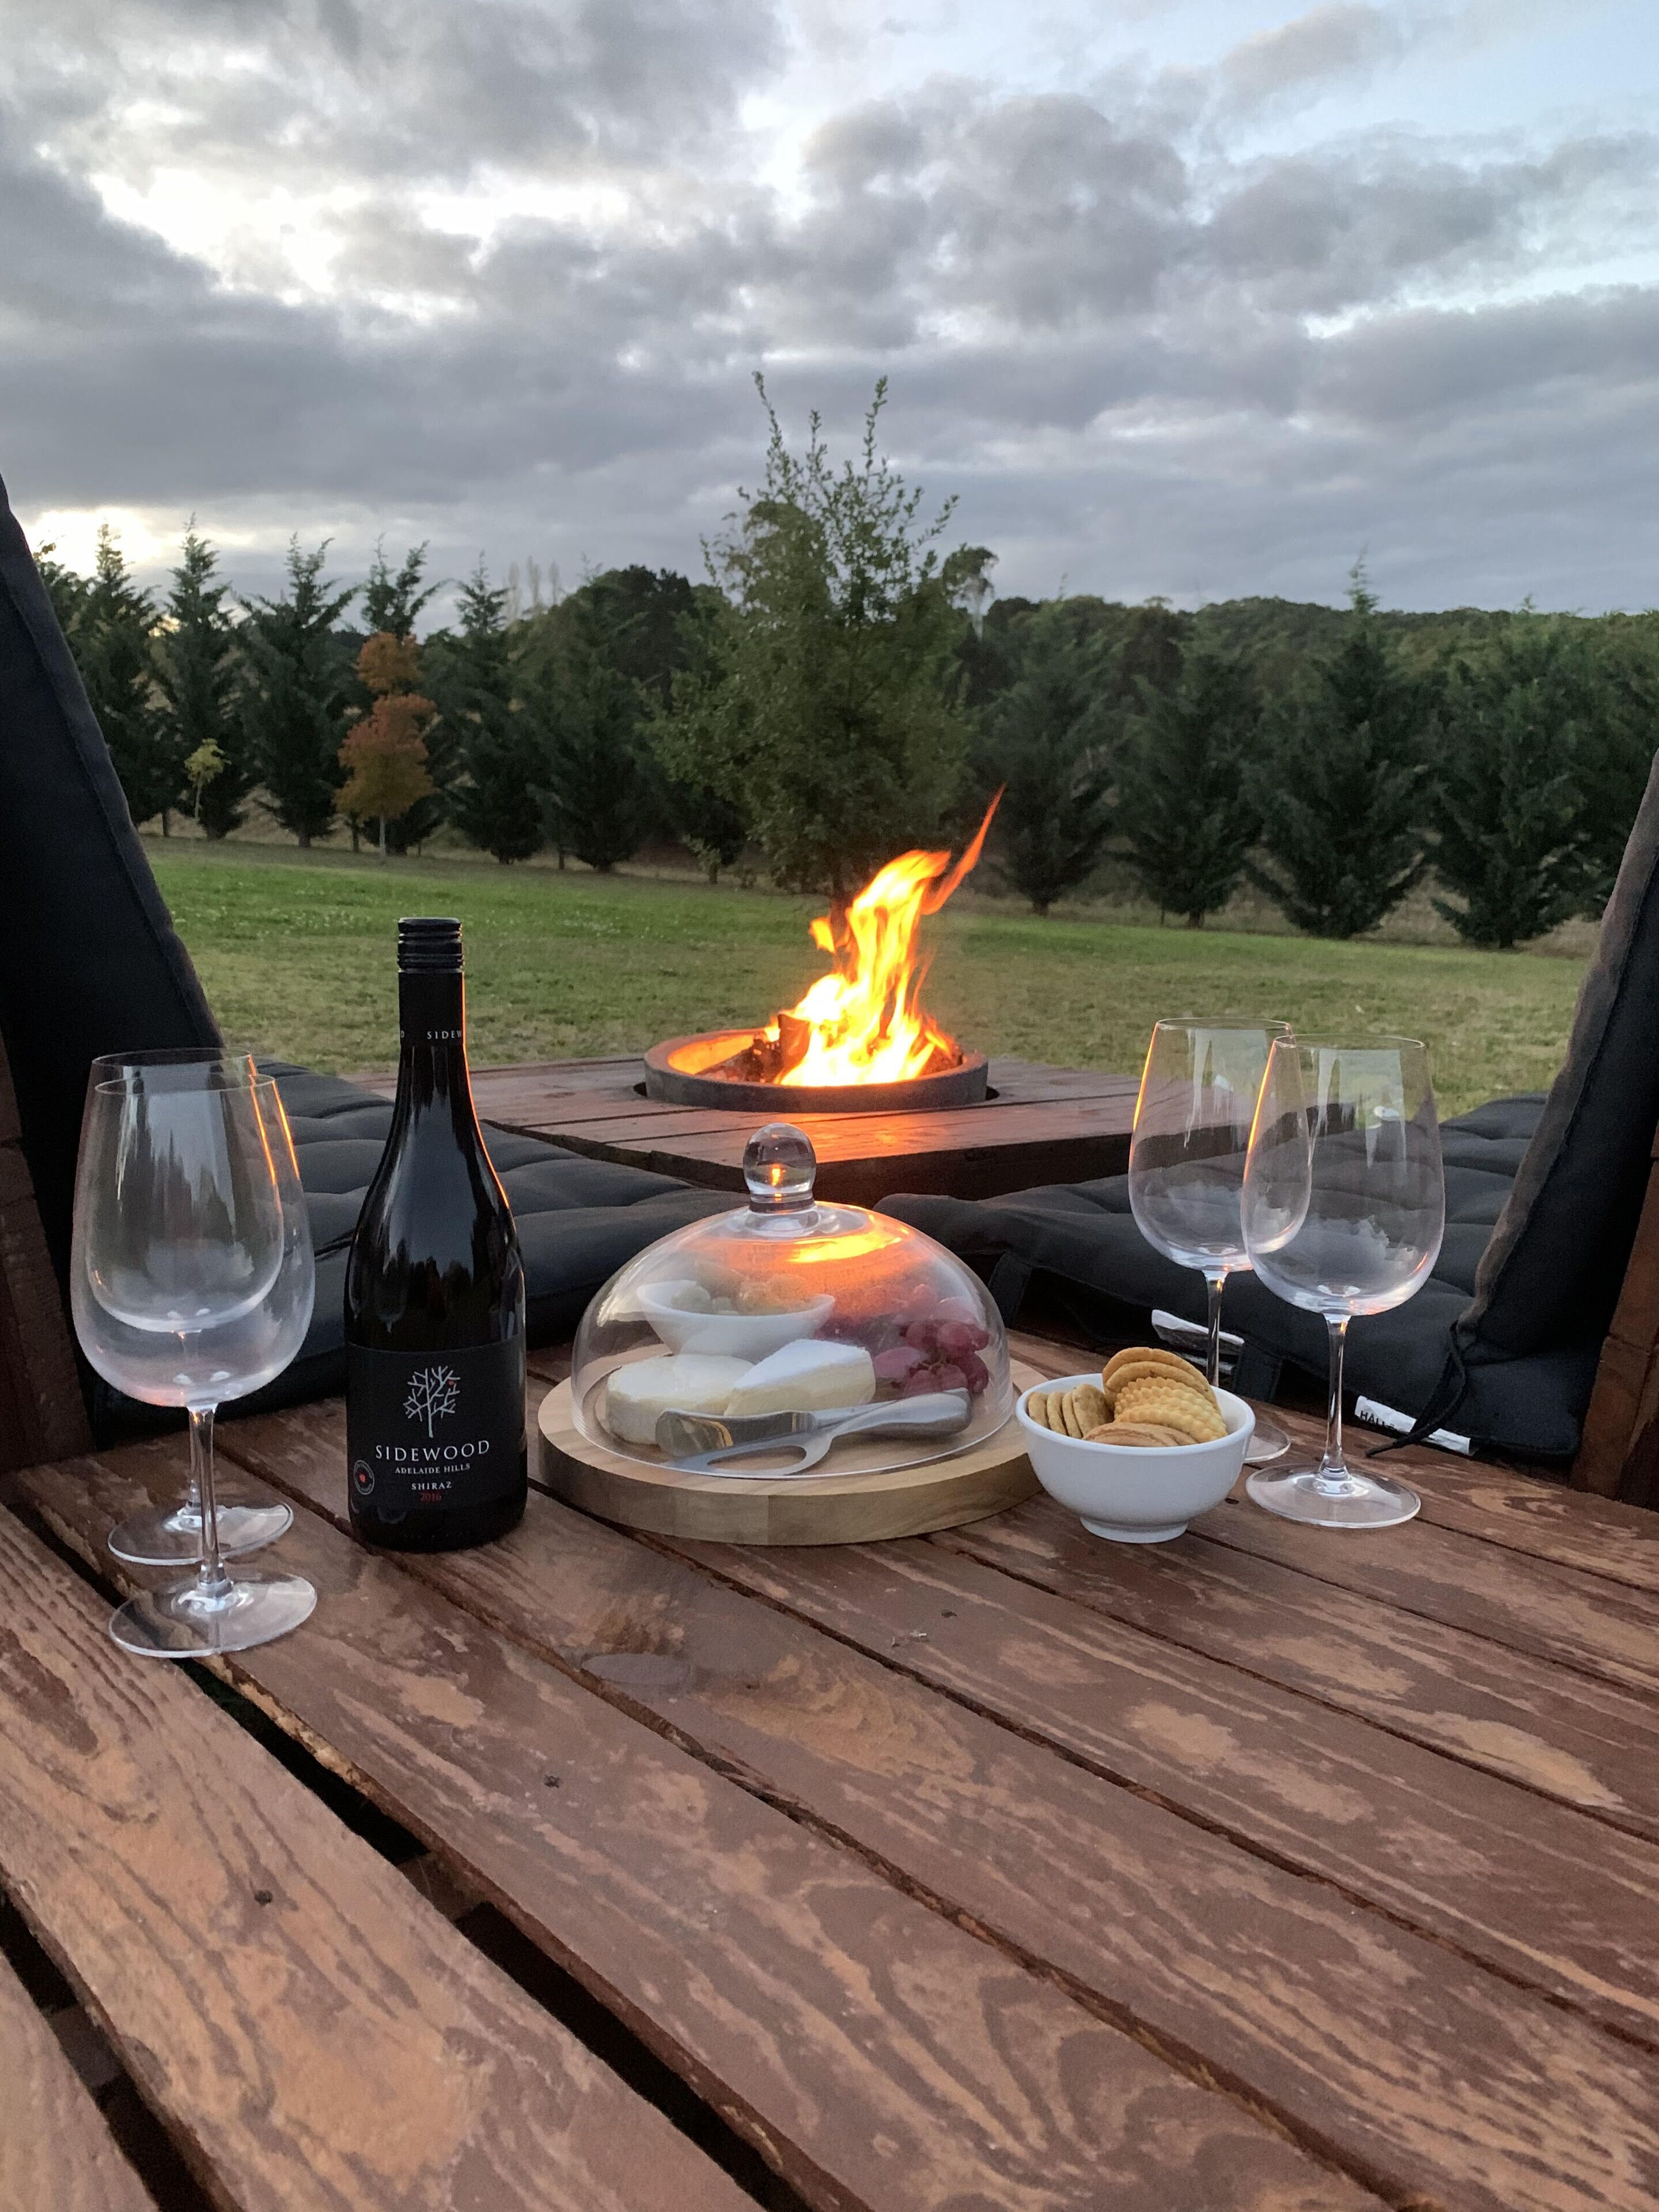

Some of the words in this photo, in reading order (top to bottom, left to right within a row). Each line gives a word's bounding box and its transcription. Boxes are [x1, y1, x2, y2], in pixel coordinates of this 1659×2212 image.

[376, 1440, 489, 1461] SIDEWOOD
[395, 1464, 440, 1475] ADELAIDE
[444, 1463, 470, 1472] HILLS
[411, 1481, 452, 1491] SHIRAZ
